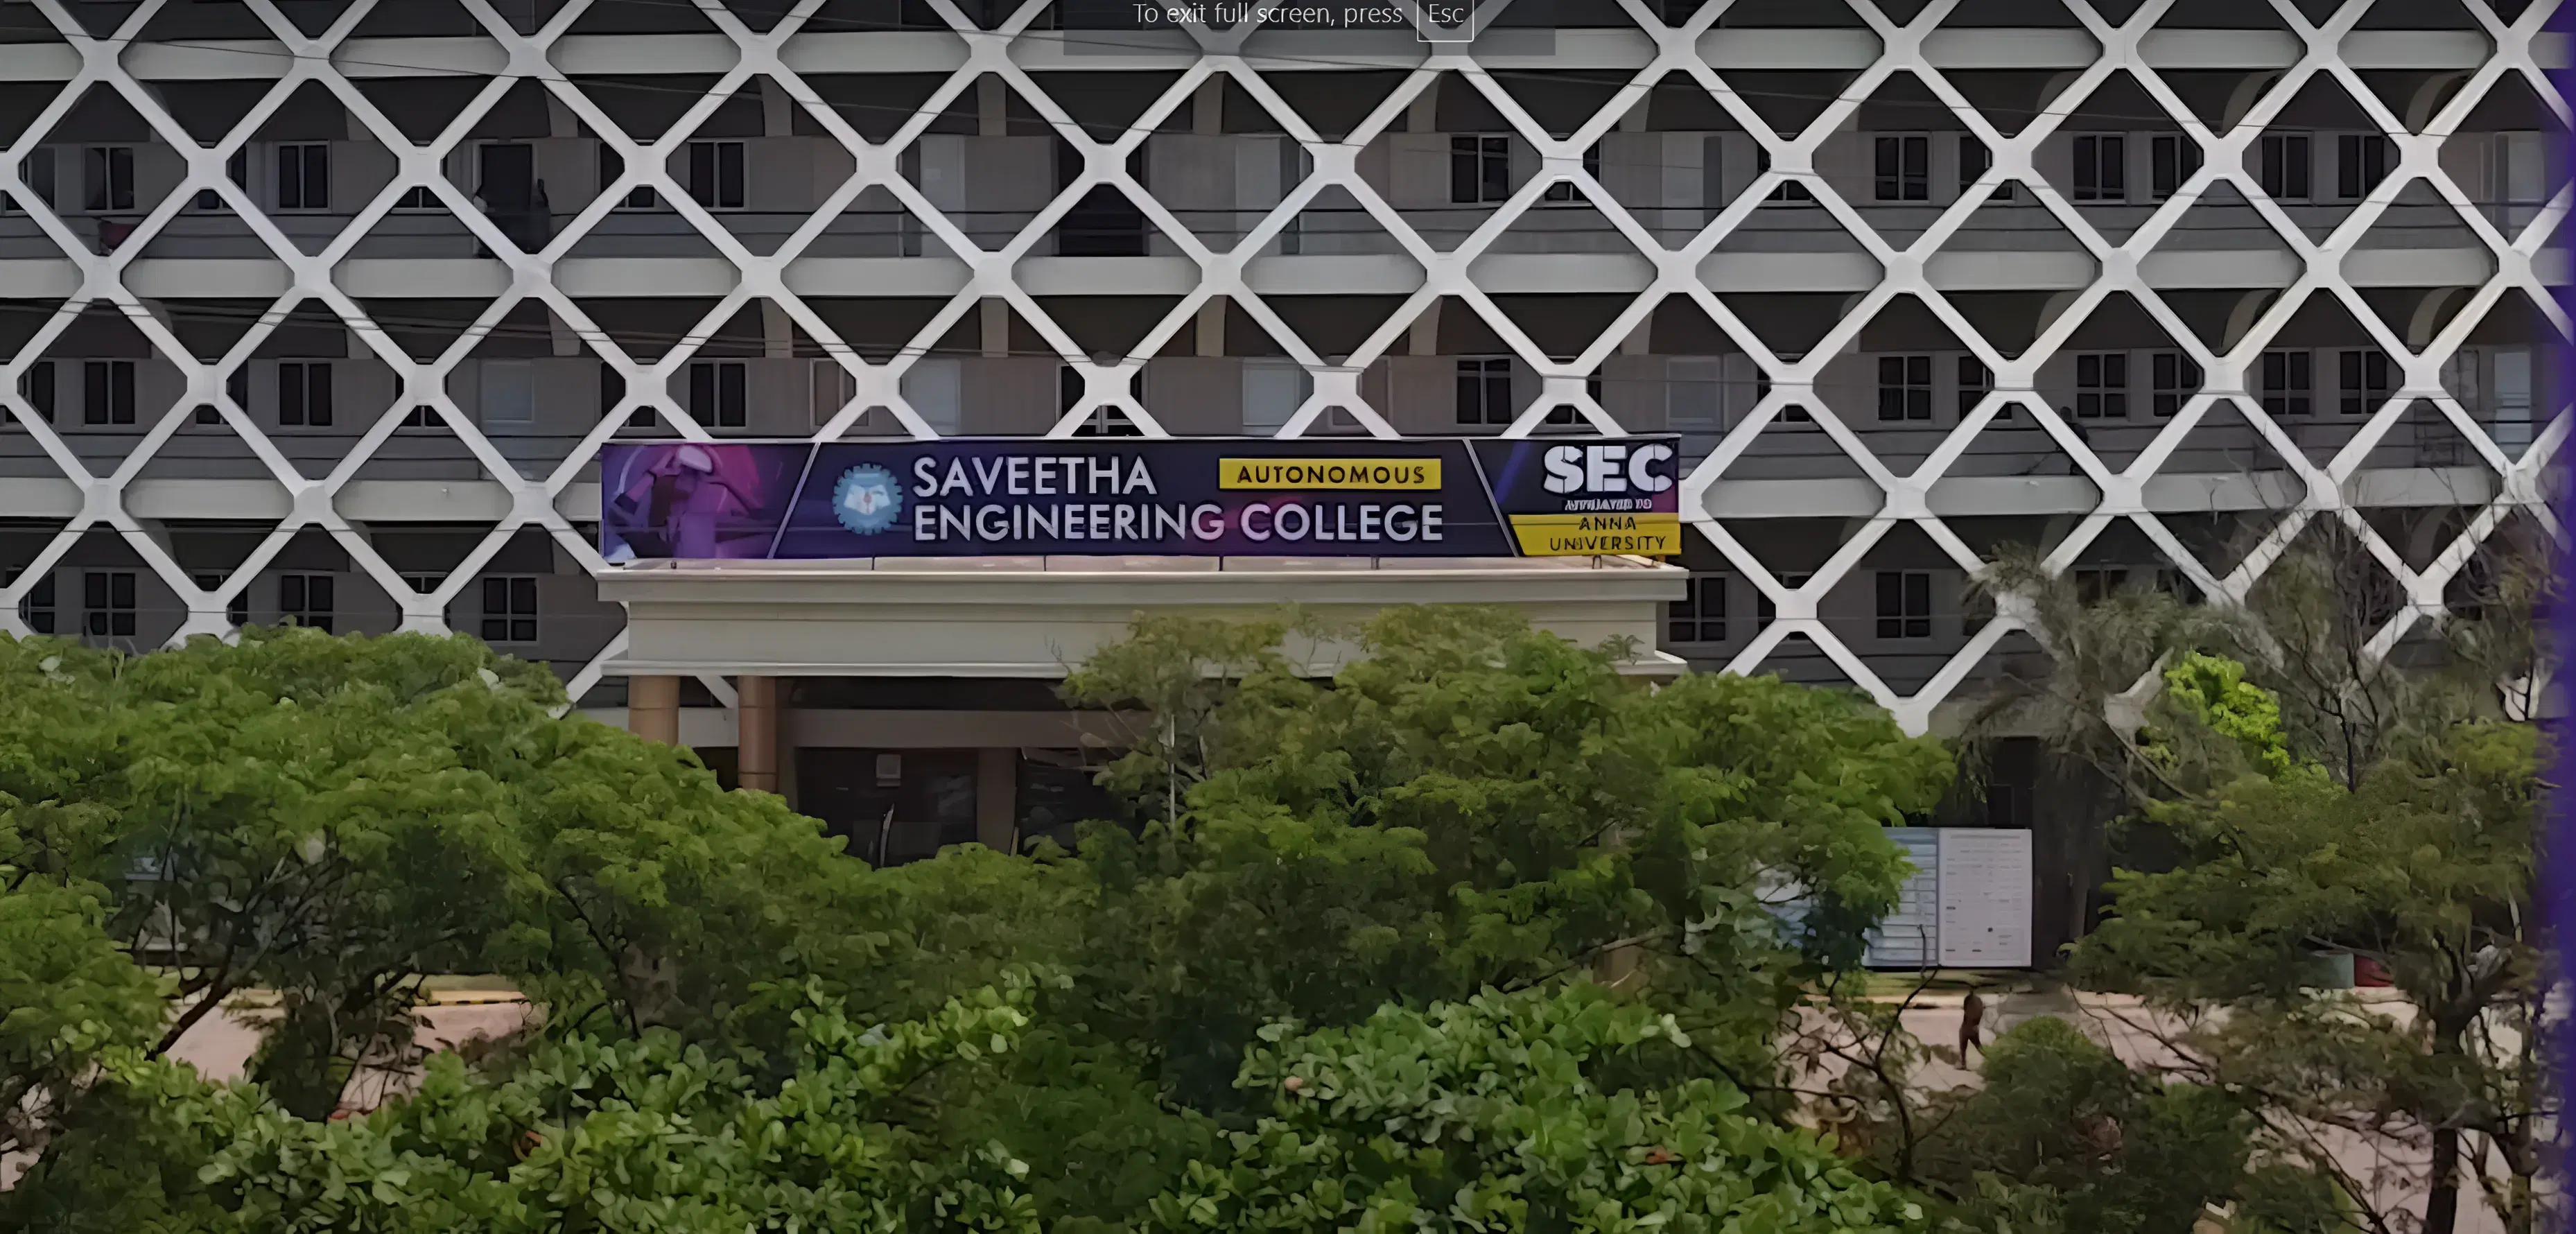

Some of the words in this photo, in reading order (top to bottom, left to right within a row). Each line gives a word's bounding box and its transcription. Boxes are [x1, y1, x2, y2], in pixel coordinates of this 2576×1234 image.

[912, 455, 1158, 497] SAVEETHA
[1237, 464, 1425, 484] AUTONOMOUS
[1543, 443, 1673, 494] SEC
[914, 503, 1226, 541] ENGINEERING
[1240, 503, 1443, 541] COLLEGE
[1578, 516, 1637, 530] ANNA
[1549, 535, 1666, 551] UNIVERSITY
